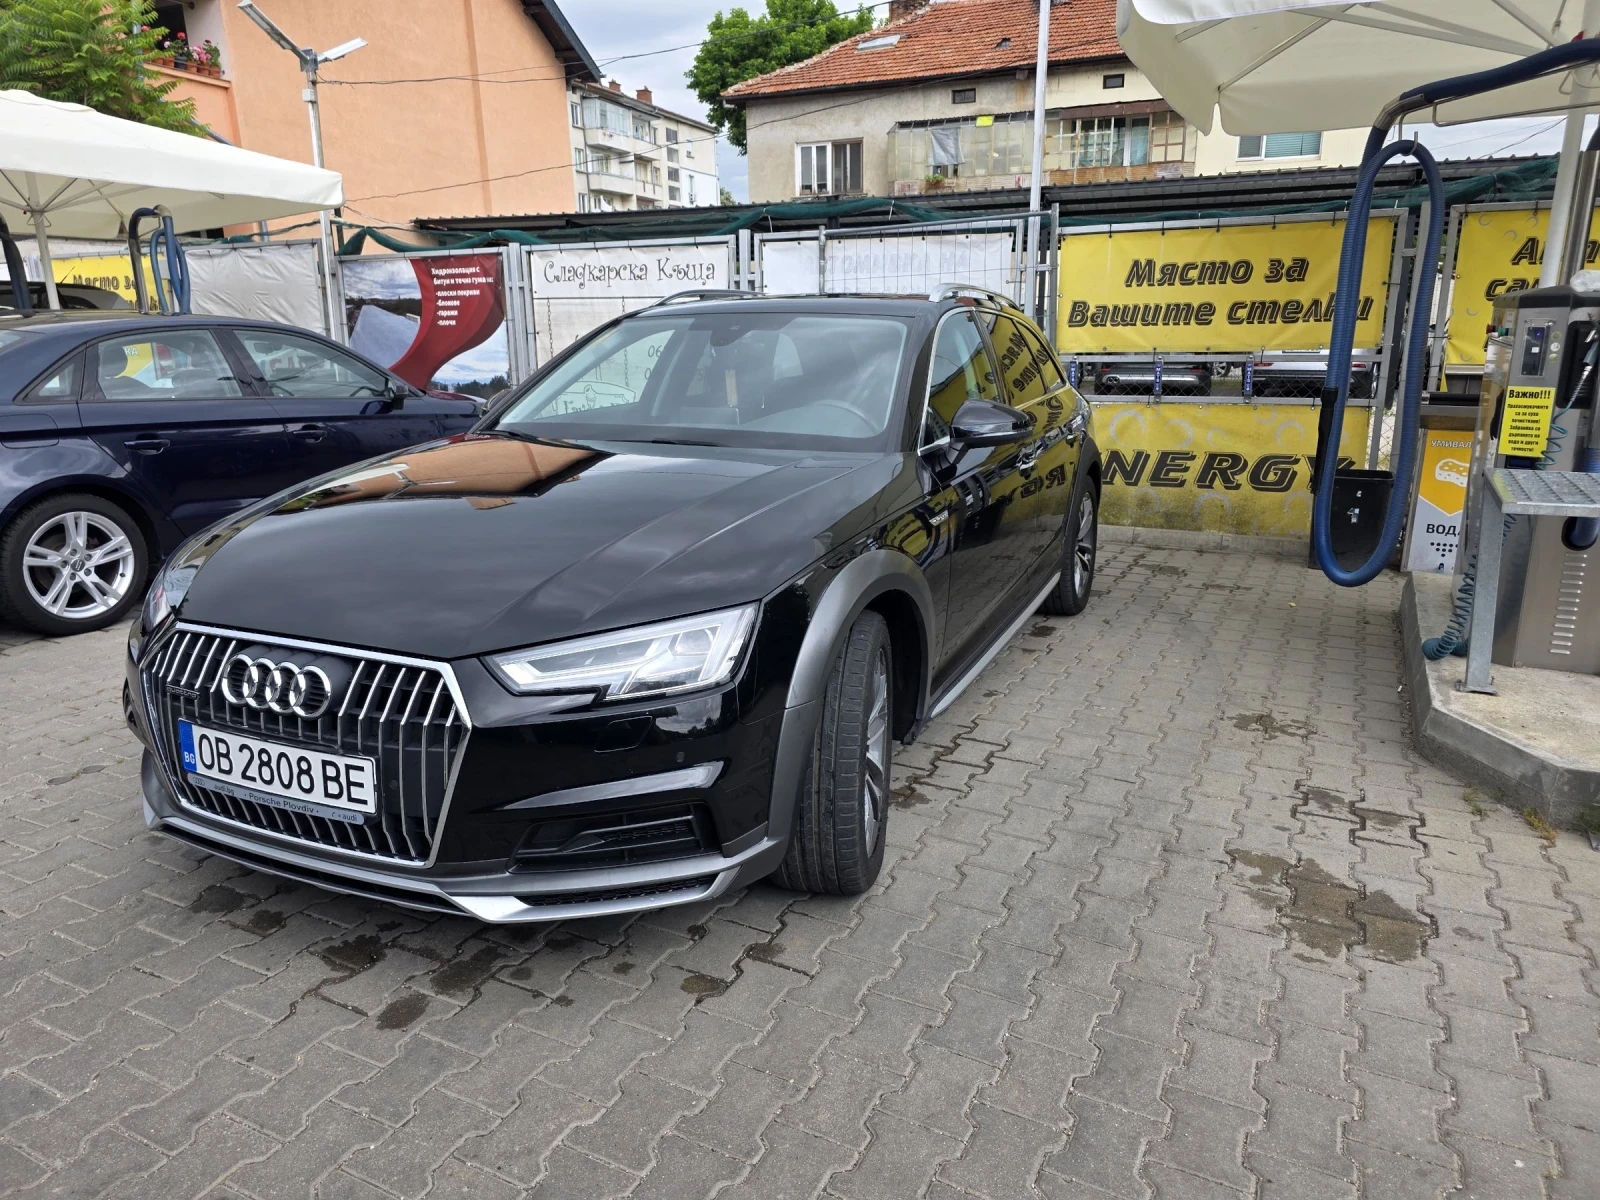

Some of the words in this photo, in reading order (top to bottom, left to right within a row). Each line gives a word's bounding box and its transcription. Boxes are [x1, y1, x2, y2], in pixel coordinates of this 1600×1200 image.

[544, 260, 648, 289] Сладкарска
[656, 257, 715, 286] Къща
[1124, 257, 1254, 287] Място
[1264, 256, 1310, 283] за
[1067, 299, 1217, 327] Вашите
[1508, 389, 1551, 399] Важно!!!
[184, 751, 196, 764] BG
[199, 733, 234, 775] OB
[238, 743, 315, 794] 2808
[321, 759, 369, 805] BE
[214, 783, 235, 796] audi.bg
[248, 792, 281, 807] Porsche
[283, 800, 314, 813] Plovdiv
